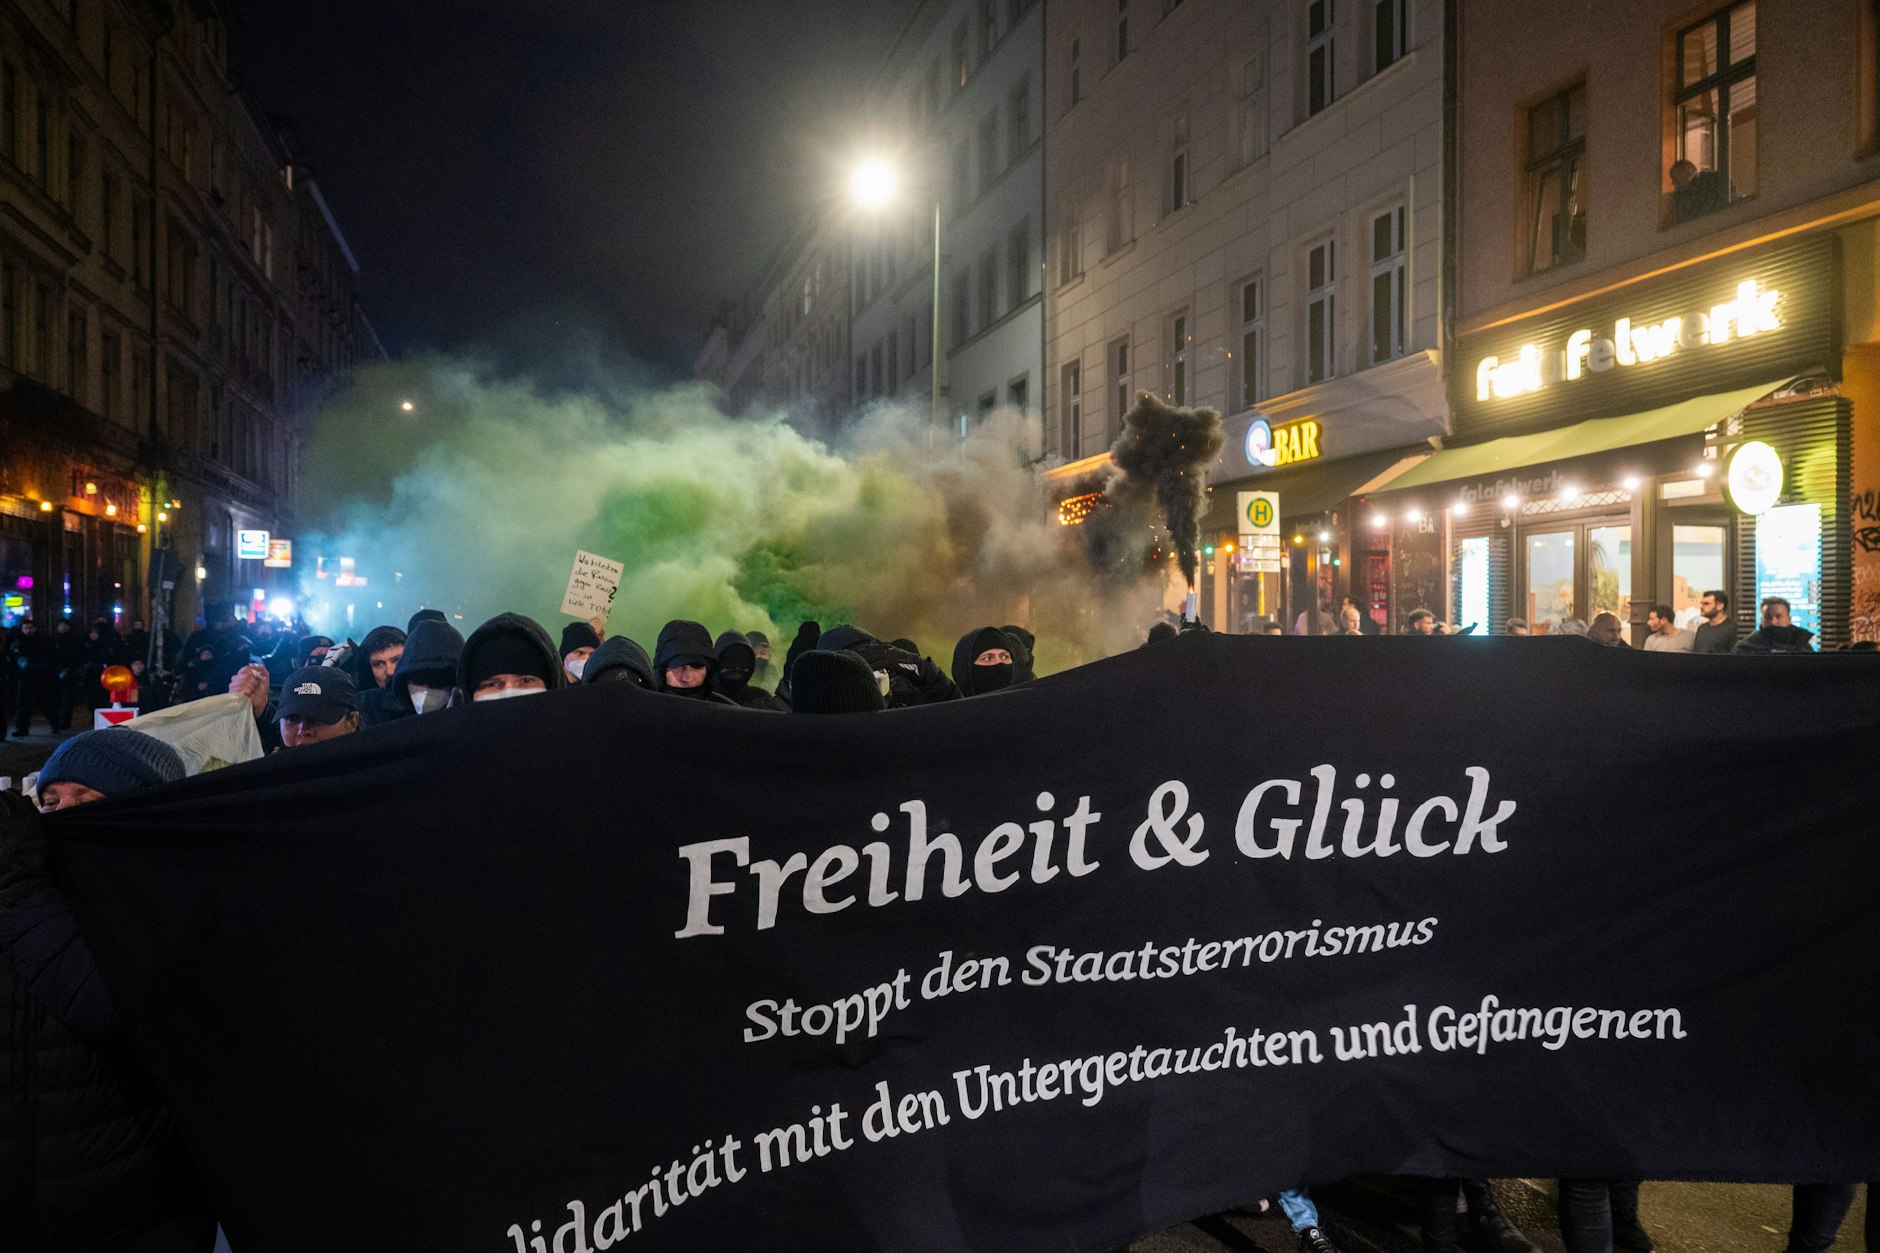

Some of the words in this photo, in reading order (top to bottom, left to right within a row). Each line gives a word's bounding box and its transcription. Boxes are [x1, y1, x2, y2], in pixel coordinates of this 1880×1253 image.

[1476, 279, 1780, 401] falafelwerk
[1273, 421, 1319, 467] BAR
[1460, 470, 1563, 503] falafelwerk
[1255, 505, 1268, 521] H
[674, 791, 1102, 939] Freiheit
[1128, 778, 1210, 871] &
[1234, 763, 1517, 861] Glück
[743, 968, 911, 1045] Stoppt
[920, 950, 1012, 1000] den
[1021, 916, 1439, 987] Staatsterrorismus
[753, 1102, 855, 1173] mit
[861, 1081, 951, 1143] den
[952, 1026, 1325, 1120] Untergetauchten
[1329, 1003, 1423, 1062] und
[1427, 994, 1688, 1055] Gefangenen
